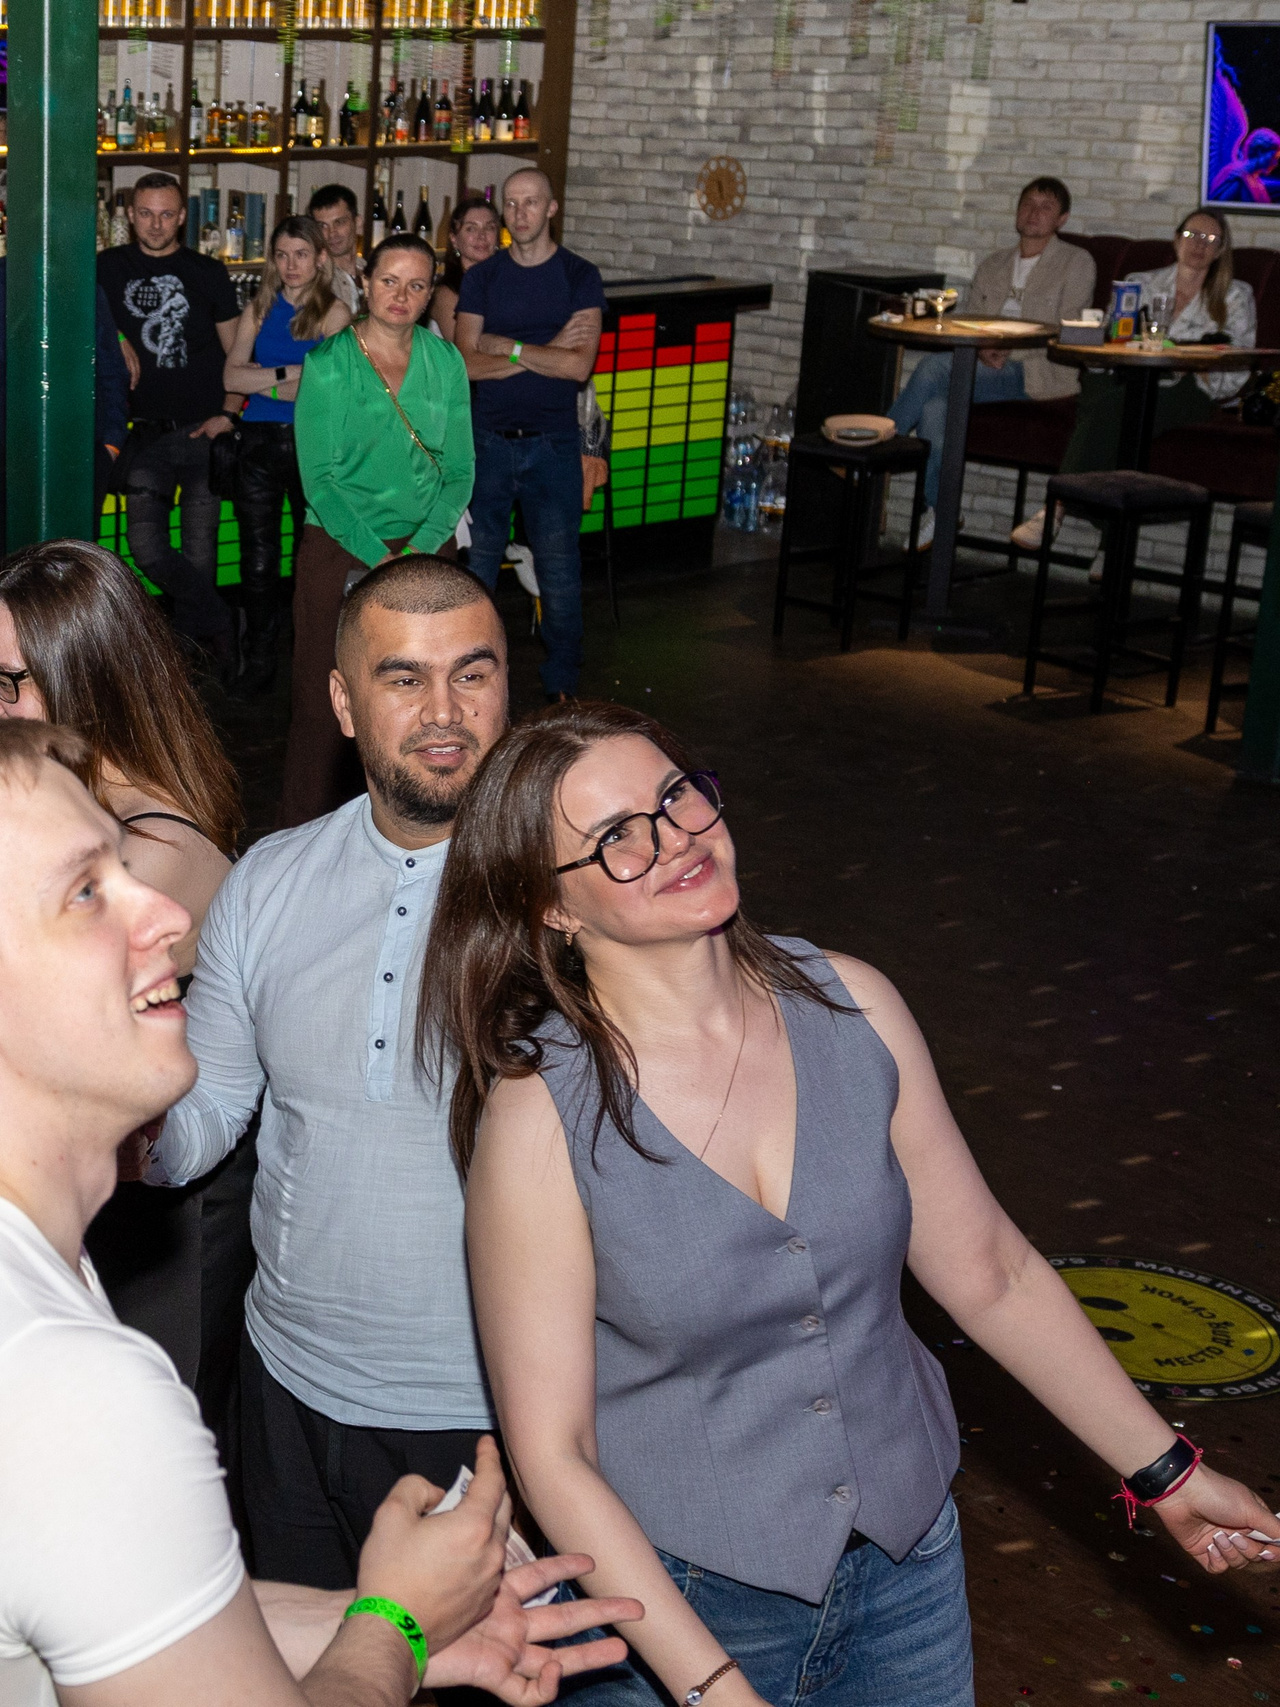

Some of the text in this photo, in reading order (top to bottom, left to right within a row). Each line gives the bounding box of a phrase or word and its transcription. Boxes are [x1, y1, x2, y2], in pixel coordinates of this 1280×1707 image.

[1134, 1261, 1212, 1284] MADE
[1215, 1282, 1243, 1295] IN
[1140, 1284, 1235, 1367] МЕСТО ДЛЯ СУМОК
